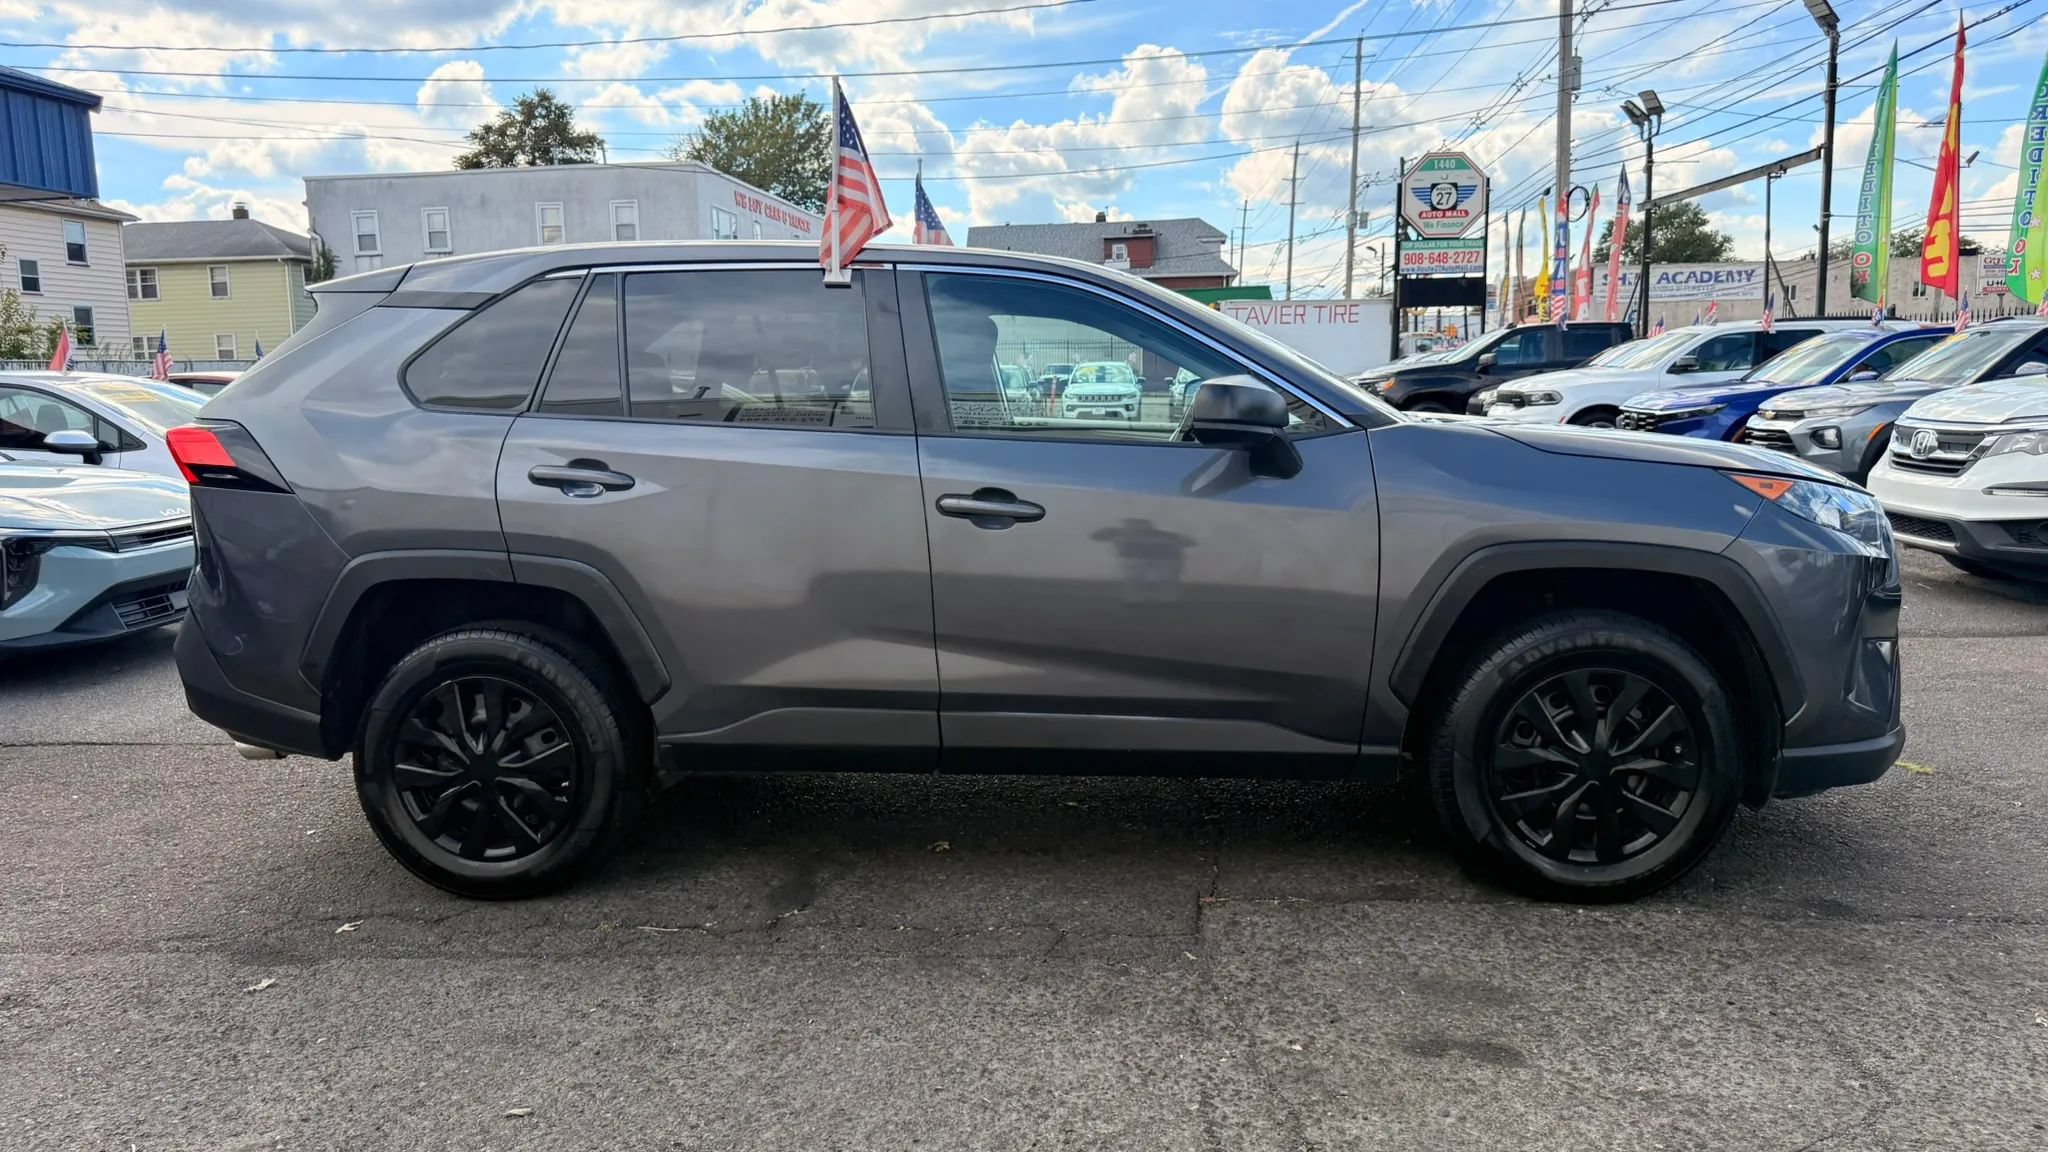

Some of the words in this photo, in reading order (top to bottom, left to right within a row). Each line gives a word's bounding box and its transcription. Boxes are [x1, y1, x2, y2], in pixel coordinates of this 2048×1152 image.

[1434, 159, 1456, 169] 1440
[1436, 192, 1453, 206] 27
[1403, 250, 1480, 265] 908-648-2727
[1656, 269, 1756, 285] ACADEMY
[1313, 304, 1361, 324] TIRE
